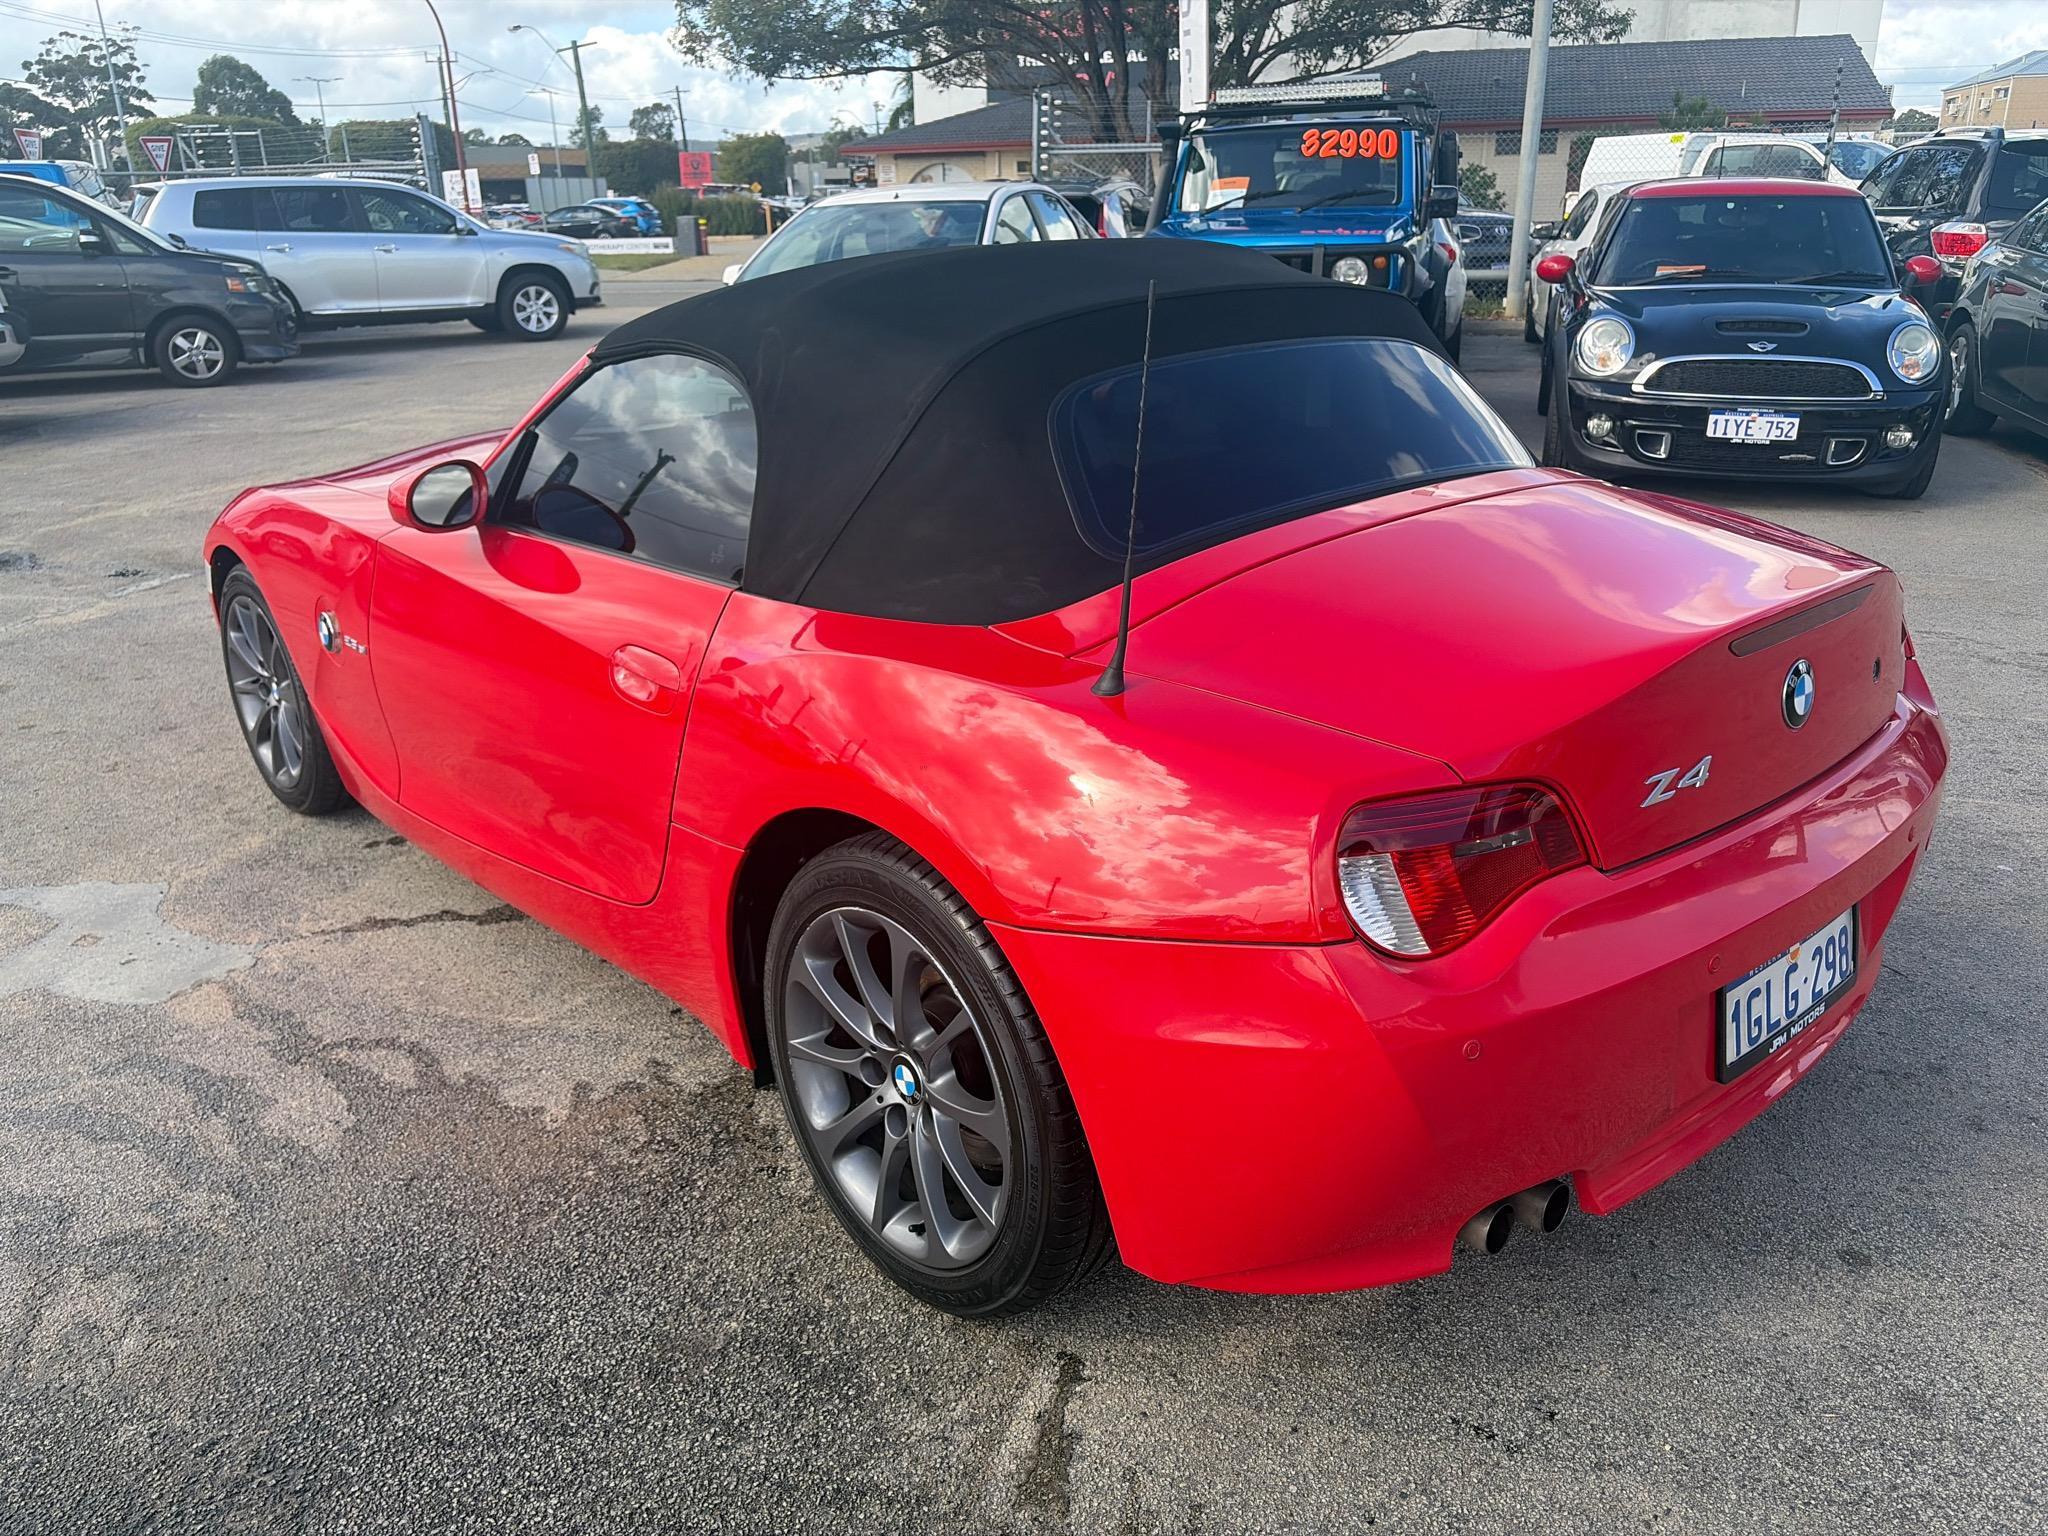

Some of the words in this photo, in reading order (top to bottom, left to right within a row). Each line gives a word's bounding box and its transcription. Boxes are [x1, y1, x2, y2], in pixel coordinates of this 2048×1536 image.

[1300, 128, 1398, 159] 32990
[1640, 755, 1713, 808] Z4
[1790, 1002, 1826, 1036] MOTORS
